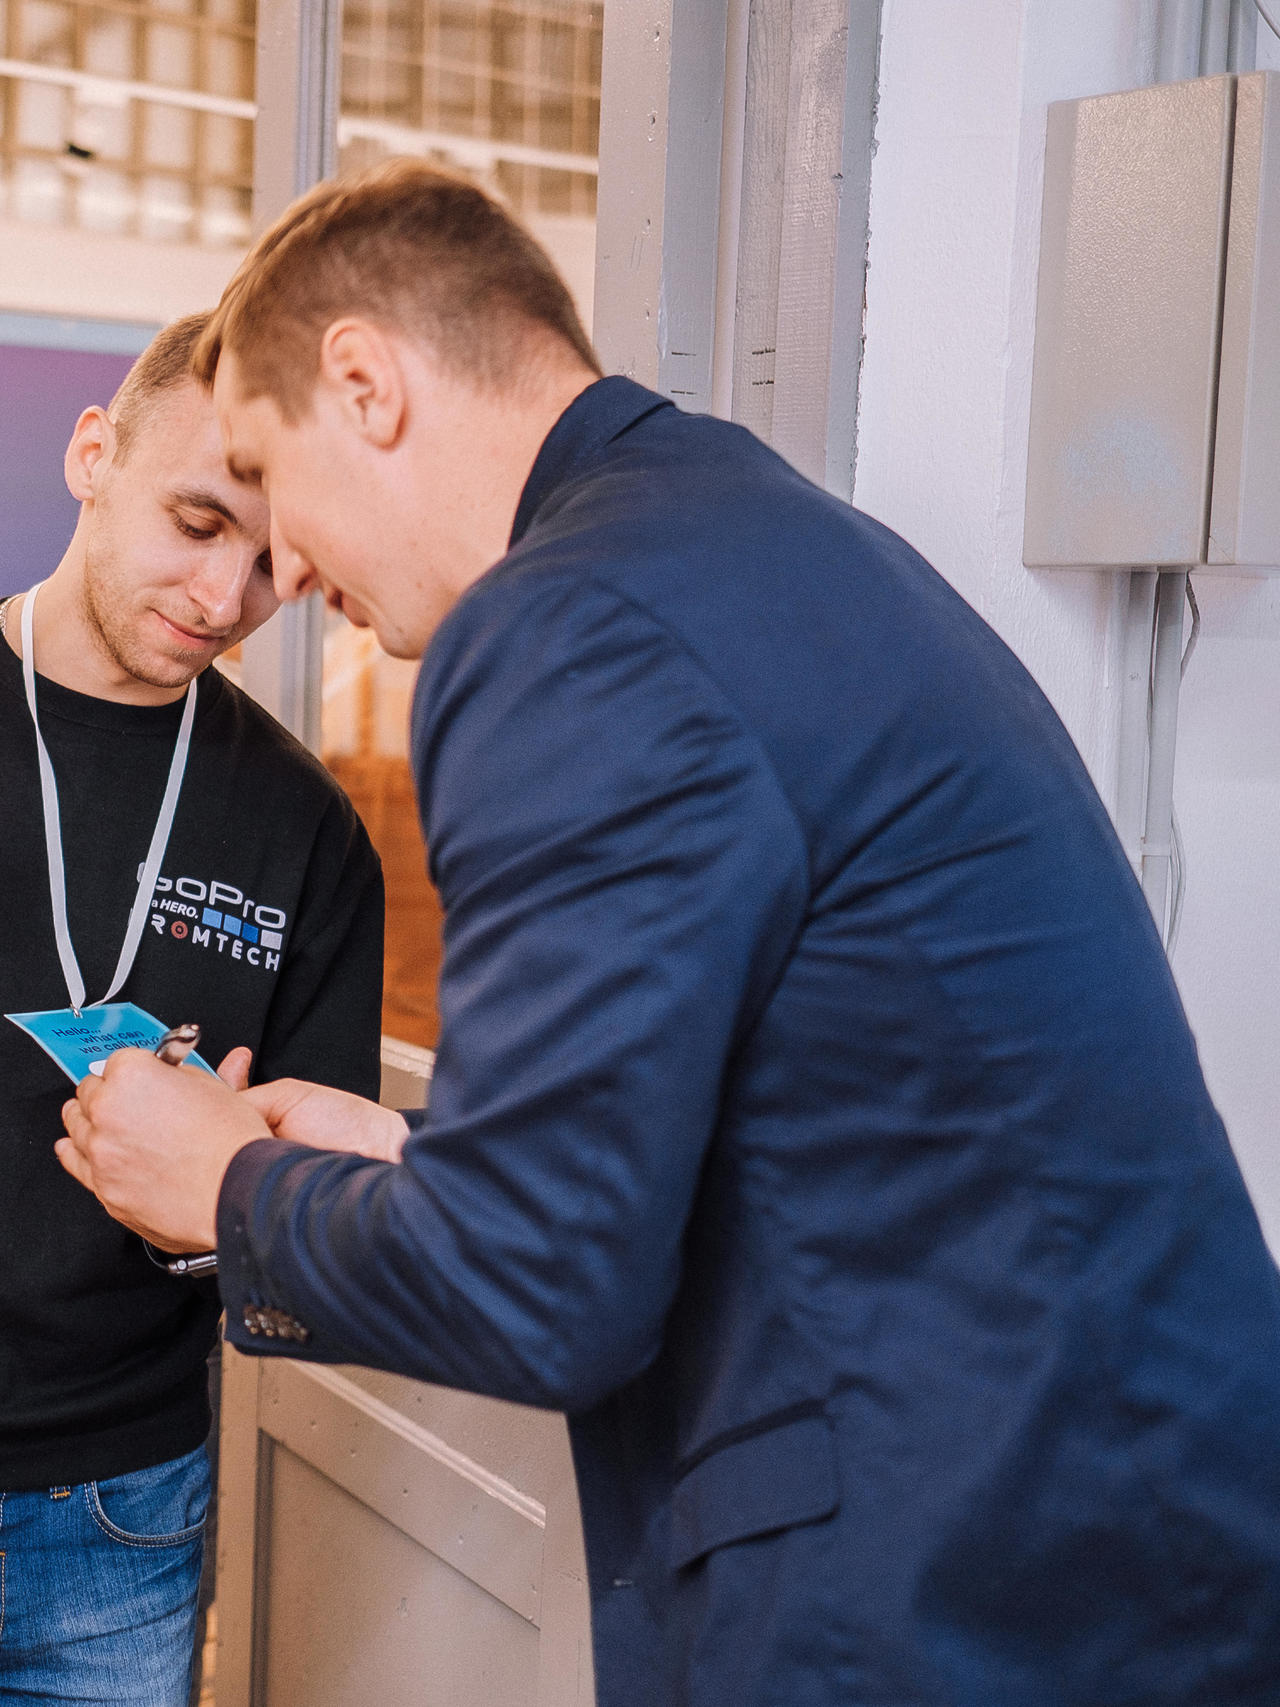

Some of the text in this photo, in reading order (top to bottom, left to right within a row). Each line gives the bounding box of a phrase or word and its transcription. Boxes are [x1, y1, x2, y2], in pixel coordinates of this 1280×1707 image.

[159, 898, 199, 919] HERO.
[128, 907, 280, 972] ROMTECH
[51, 1027, 101, 1038] Hello...
[79, 1030, 145, 1044] what can
[79, 1035, 160, 1054] we call you?
